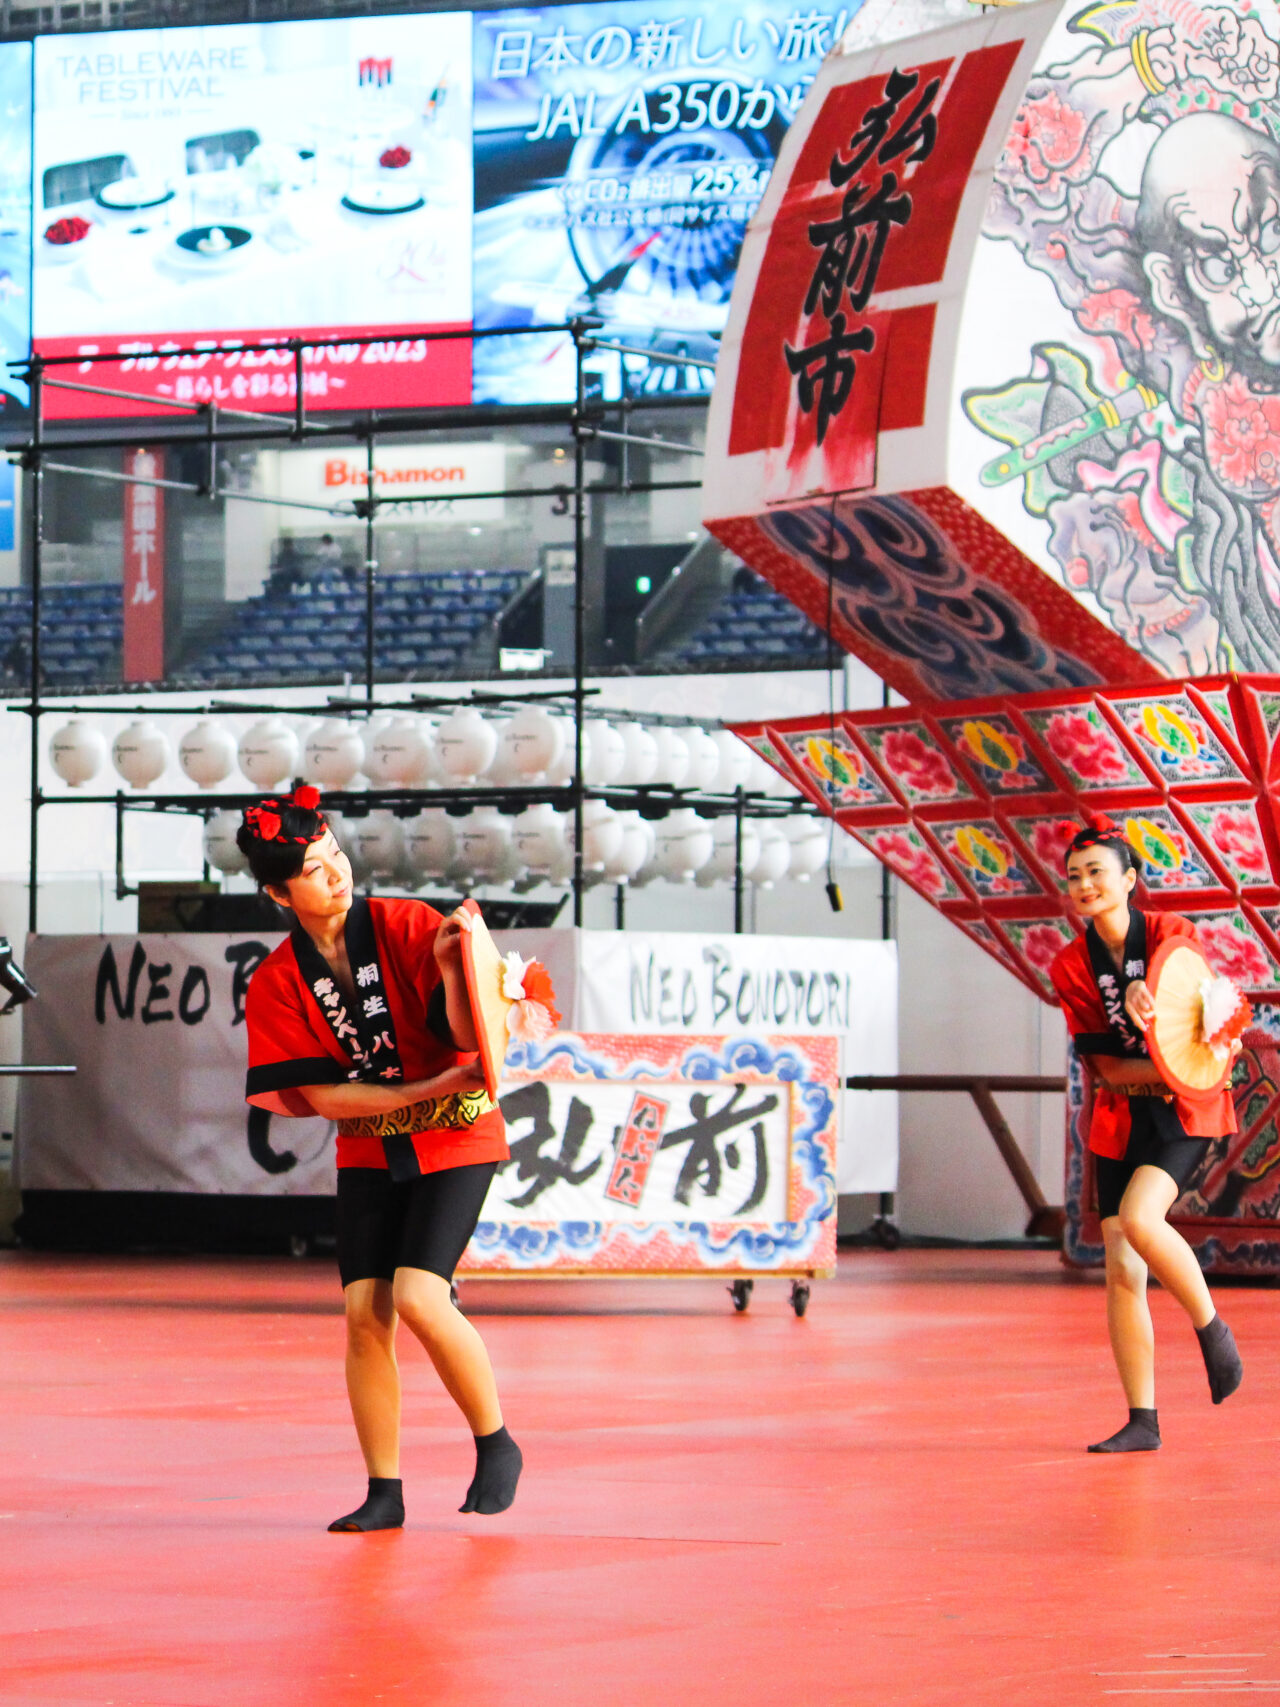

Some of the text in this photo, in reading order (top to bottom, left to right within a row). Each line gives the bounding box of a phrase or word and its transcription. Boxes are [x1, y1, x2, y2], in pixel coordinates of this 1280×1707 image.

[56, 46, 249, 78] TABLEWARE
[491, 8, 847, 80] 日本の新しい旅
[79, 76, 225, 104] FESTIVAL
[525, 90, 607, 141] JAL
[783, 66, 941, 448] 弘前市
[324, 459, 465, 487] Bishamon
[95, 940, 211, 1025] NEO
[629, 946, 698, 1027] NEO
